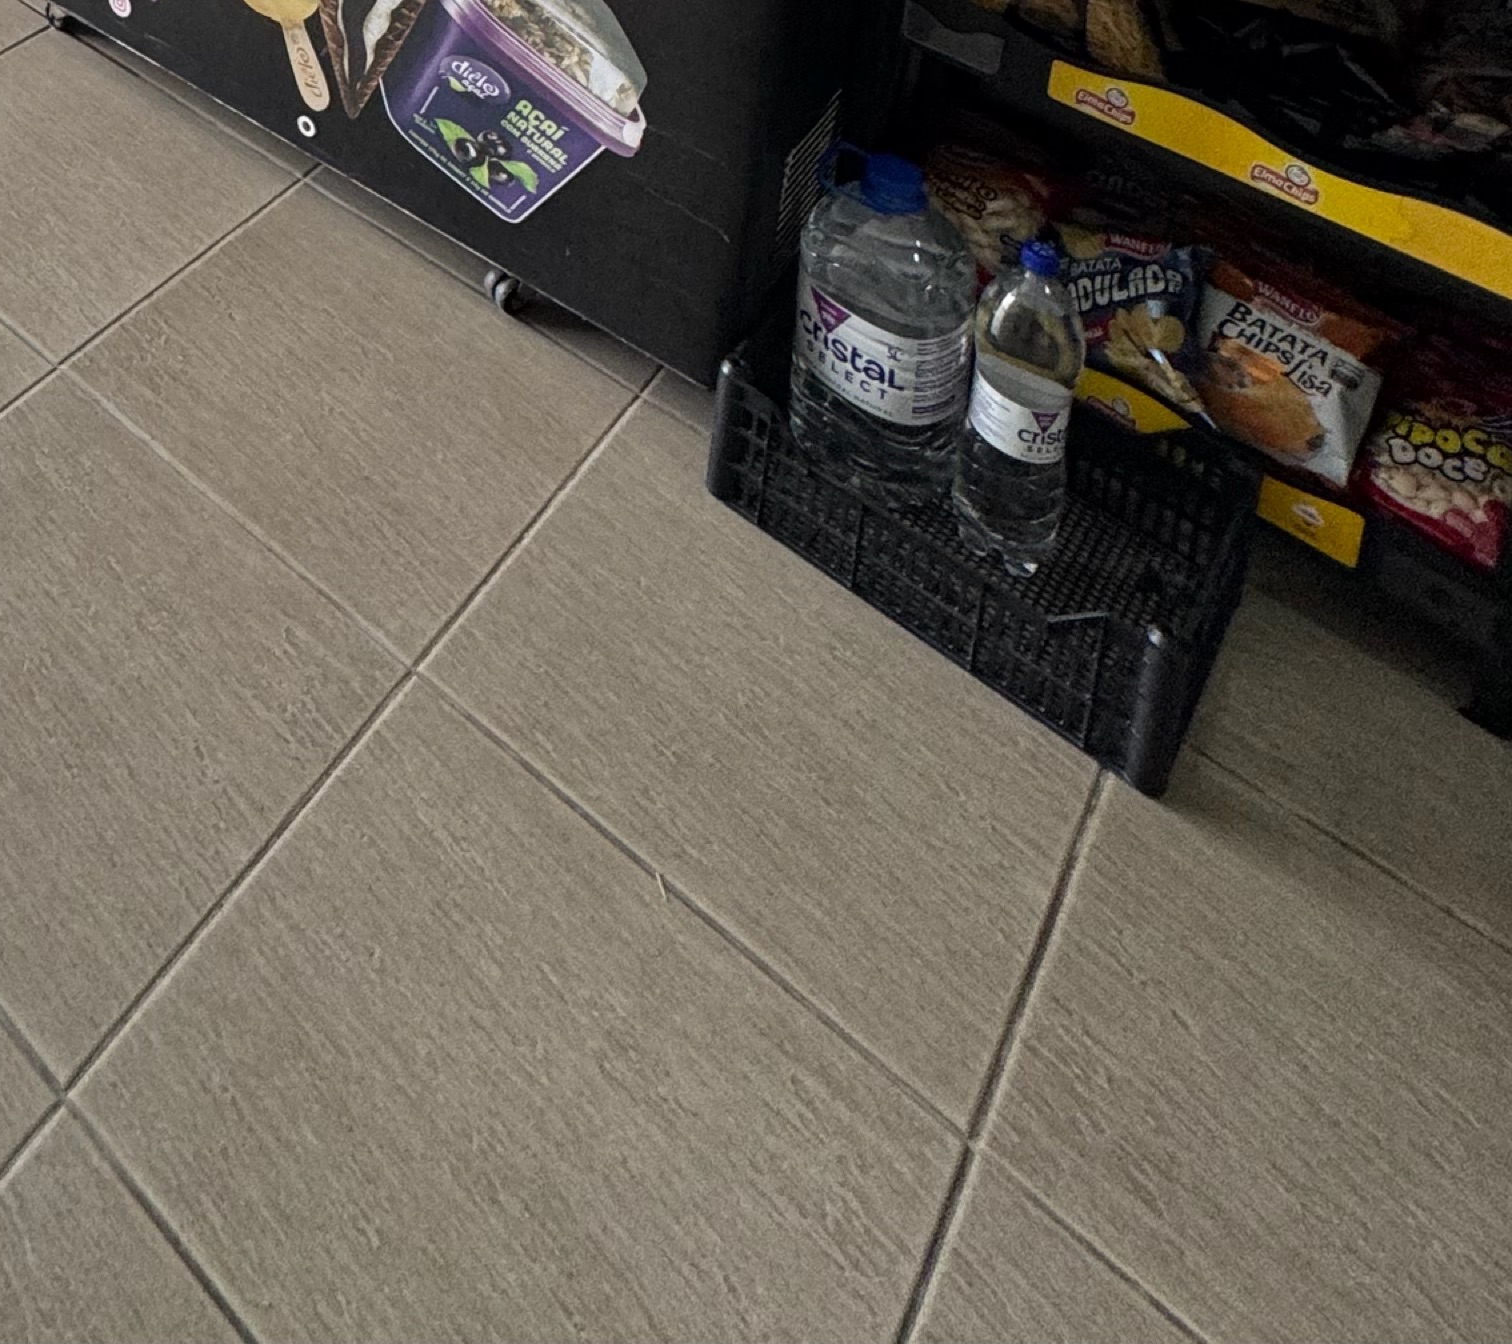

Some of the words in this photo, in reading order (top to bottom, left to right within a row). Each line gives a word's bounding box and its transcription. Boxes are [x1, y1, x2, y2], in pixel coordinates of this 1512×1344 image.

[506, 111, 569, 165] NATURAL
[1218, 318, 1293, 366] CHIPS
[1226, 301, 1329, 367] BATATA
[806, 337, 889, 401] SELECT
